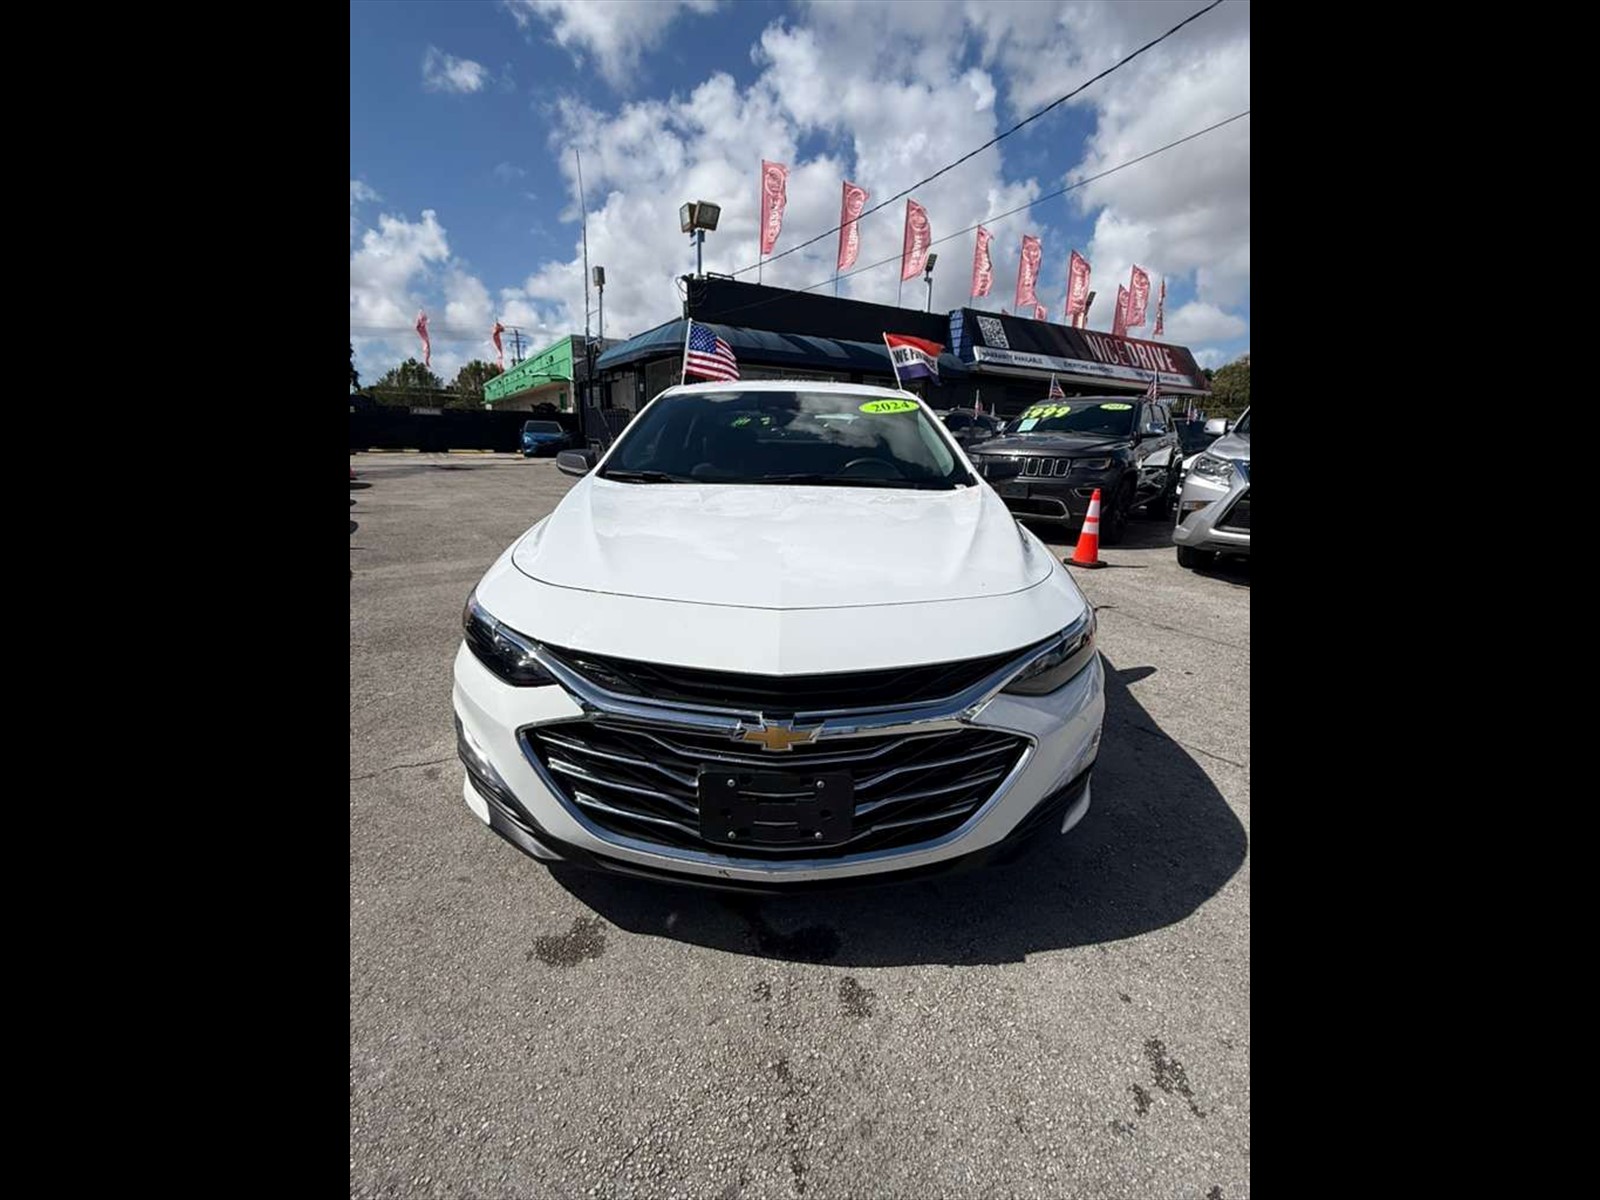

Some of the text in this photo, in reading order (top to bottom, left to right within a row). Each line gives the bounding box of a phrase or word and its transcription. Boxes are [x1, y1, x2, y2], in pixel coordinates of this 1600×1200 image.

[893, 348, 908, 363] WE
[1085, 334, 1178, 373] NICE DRIVE
[874, 402, 909, 412] 2024
